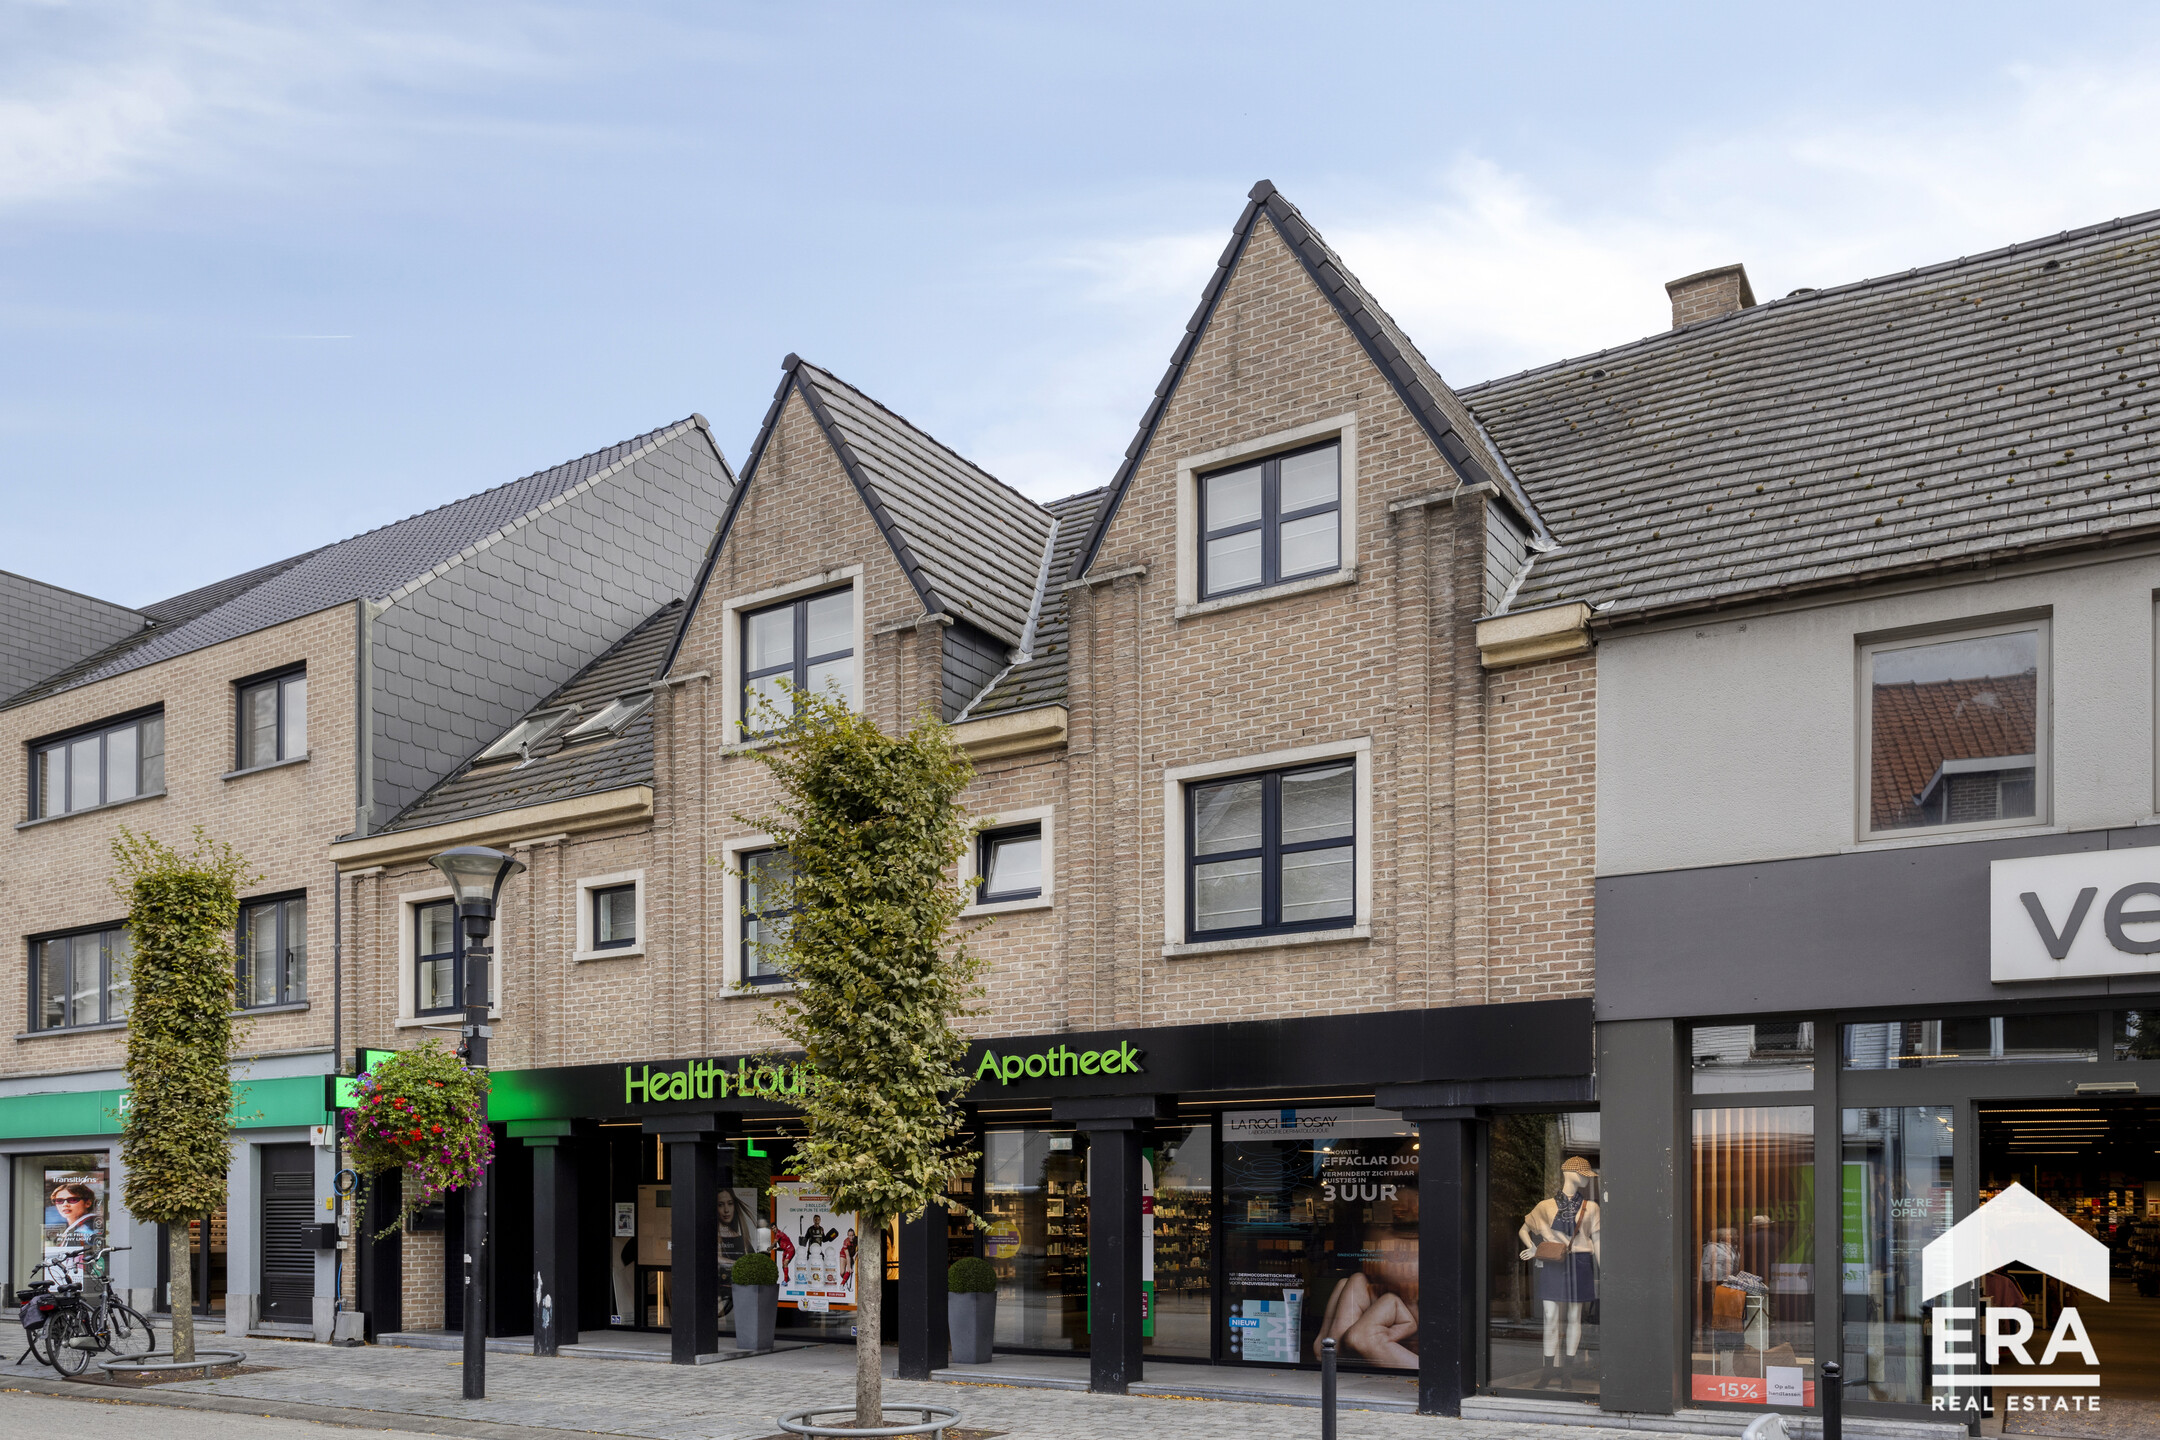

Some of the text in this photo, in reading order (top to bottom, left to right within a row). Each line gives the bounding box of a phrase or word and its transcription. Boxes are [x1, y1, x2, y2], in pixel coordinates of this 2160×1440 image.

[976, 1040, 1140, 1086] Apotheek
[626, 1058, 821, 1104] Health Loun
[1231, 1119, 1246, 1130] LA
[1248, 1117, 1292, 1130] ROCHE
[1323, 1155, 1419, 1166] EFFACLAR DUO
[1371, 1169, 1415, 1177] ZICHTBAAR
[51, 1175, 97, 1185] Transitions
[1323, 1185, 1337, 1201] 3
[1890, 1198, 1933, 1207] WE'RE
[1890, 1208, 1928, 1218] OPEN
[1707, 1382, 1758, 1398] -15%
